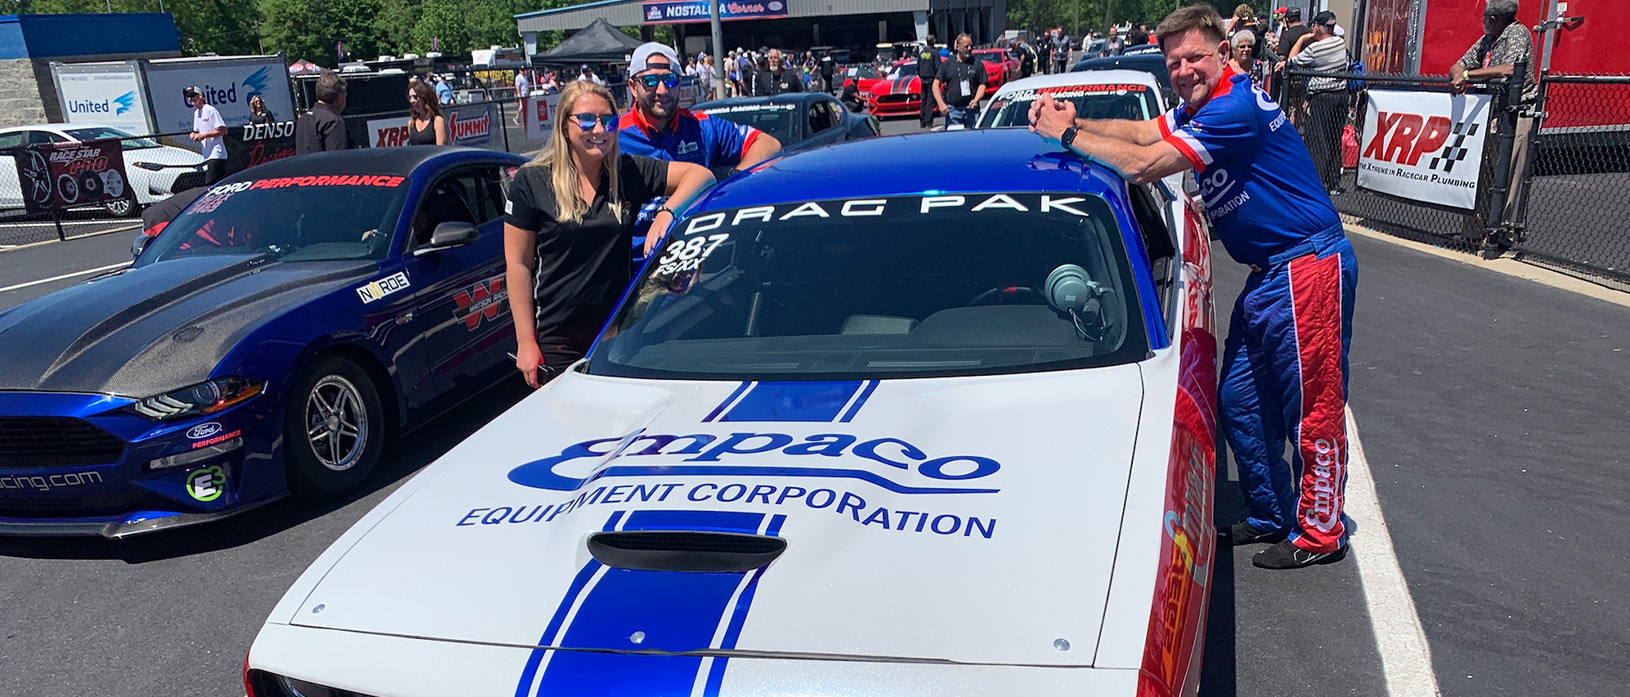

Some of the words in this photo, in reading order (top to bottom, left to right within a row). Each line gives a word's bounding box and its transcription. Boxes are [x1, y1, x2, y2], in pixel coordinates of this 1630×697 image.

[666, 4, 727, 17] NOSTALA
[183, 81, 237, 109] Uited
[998, 89, 1035, 101] FORD
[1036, 84, 1147, 95] PERFORMANCE
[68, 99, 109, 113] United
[242, 121, 295, 142] DENSO
[1363, 110, 1452, 167] XRP
[49, 150, 76, 162] RACE
[76, 148, 101, 160] STAR
[70, 156, 109, 175] PRO
[205, 181, 253, 198] FORD
[249, 174, 405, 190] PERFORMANCE
[1396, 168, 1429, 181] RACECAR
[1430, 173, 1476, 189] PLUMBING
[684, 199, 888, 236] DRAG
[920, 194, 1089, 217] PAK
[660, 233, 729, 265] 387
[652, 258, 705, 280] FS/XX
[192, 429, 241, 449] PERFORMANCE
[193, 424, 216, 437] Ford
[508, 427, 1001, 492] Empaco
[0, 471, 103, 491] cing.com
[1305, 437, 1340, 533] Empaco
[456, 484, 685, 527] EQUIPMENT
[687, 483, 998, 540] CORPORATION
